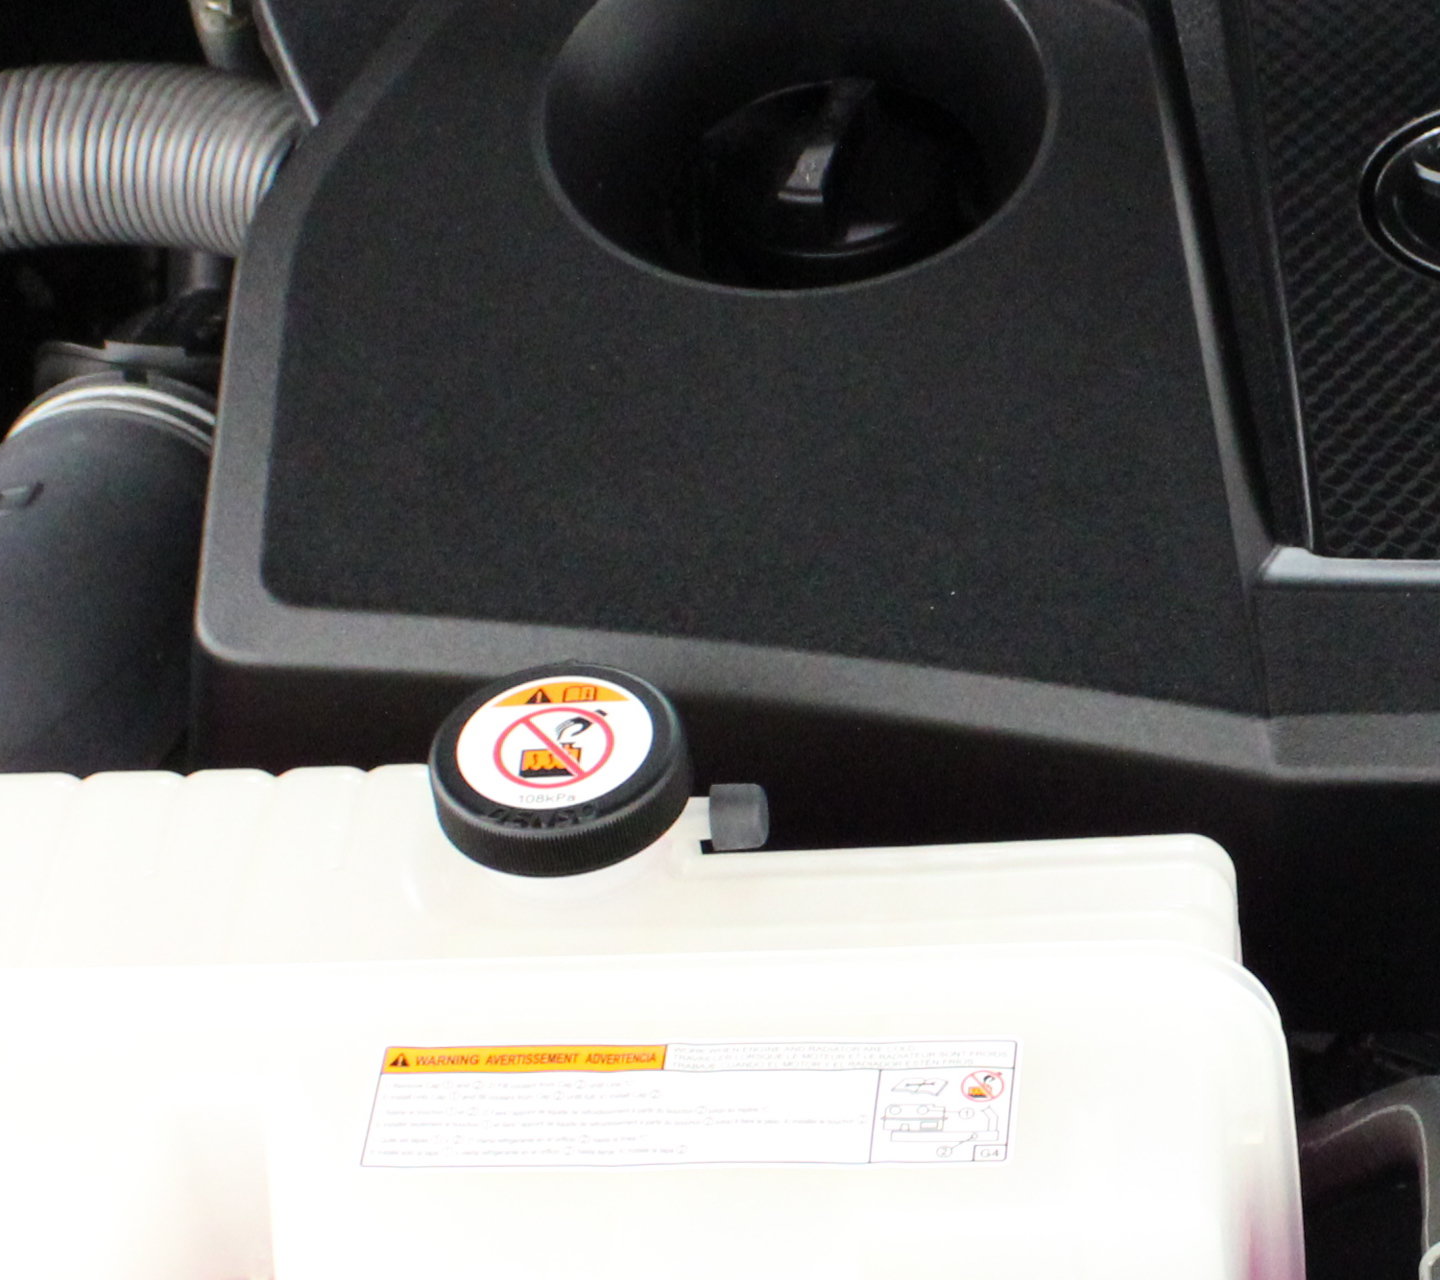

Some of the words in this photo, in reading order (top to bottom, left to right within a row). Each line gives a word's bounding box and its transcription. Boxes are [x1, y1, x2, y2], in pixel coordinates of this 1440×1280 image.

[517, 793, 577, 805] 108kPa
[415, 1053, 481, 1066] WARNING
[485, 1052, 580, 1065] AVERTISSEMENT
[584, 1052, 657, 1064] ADVERTENCIA
